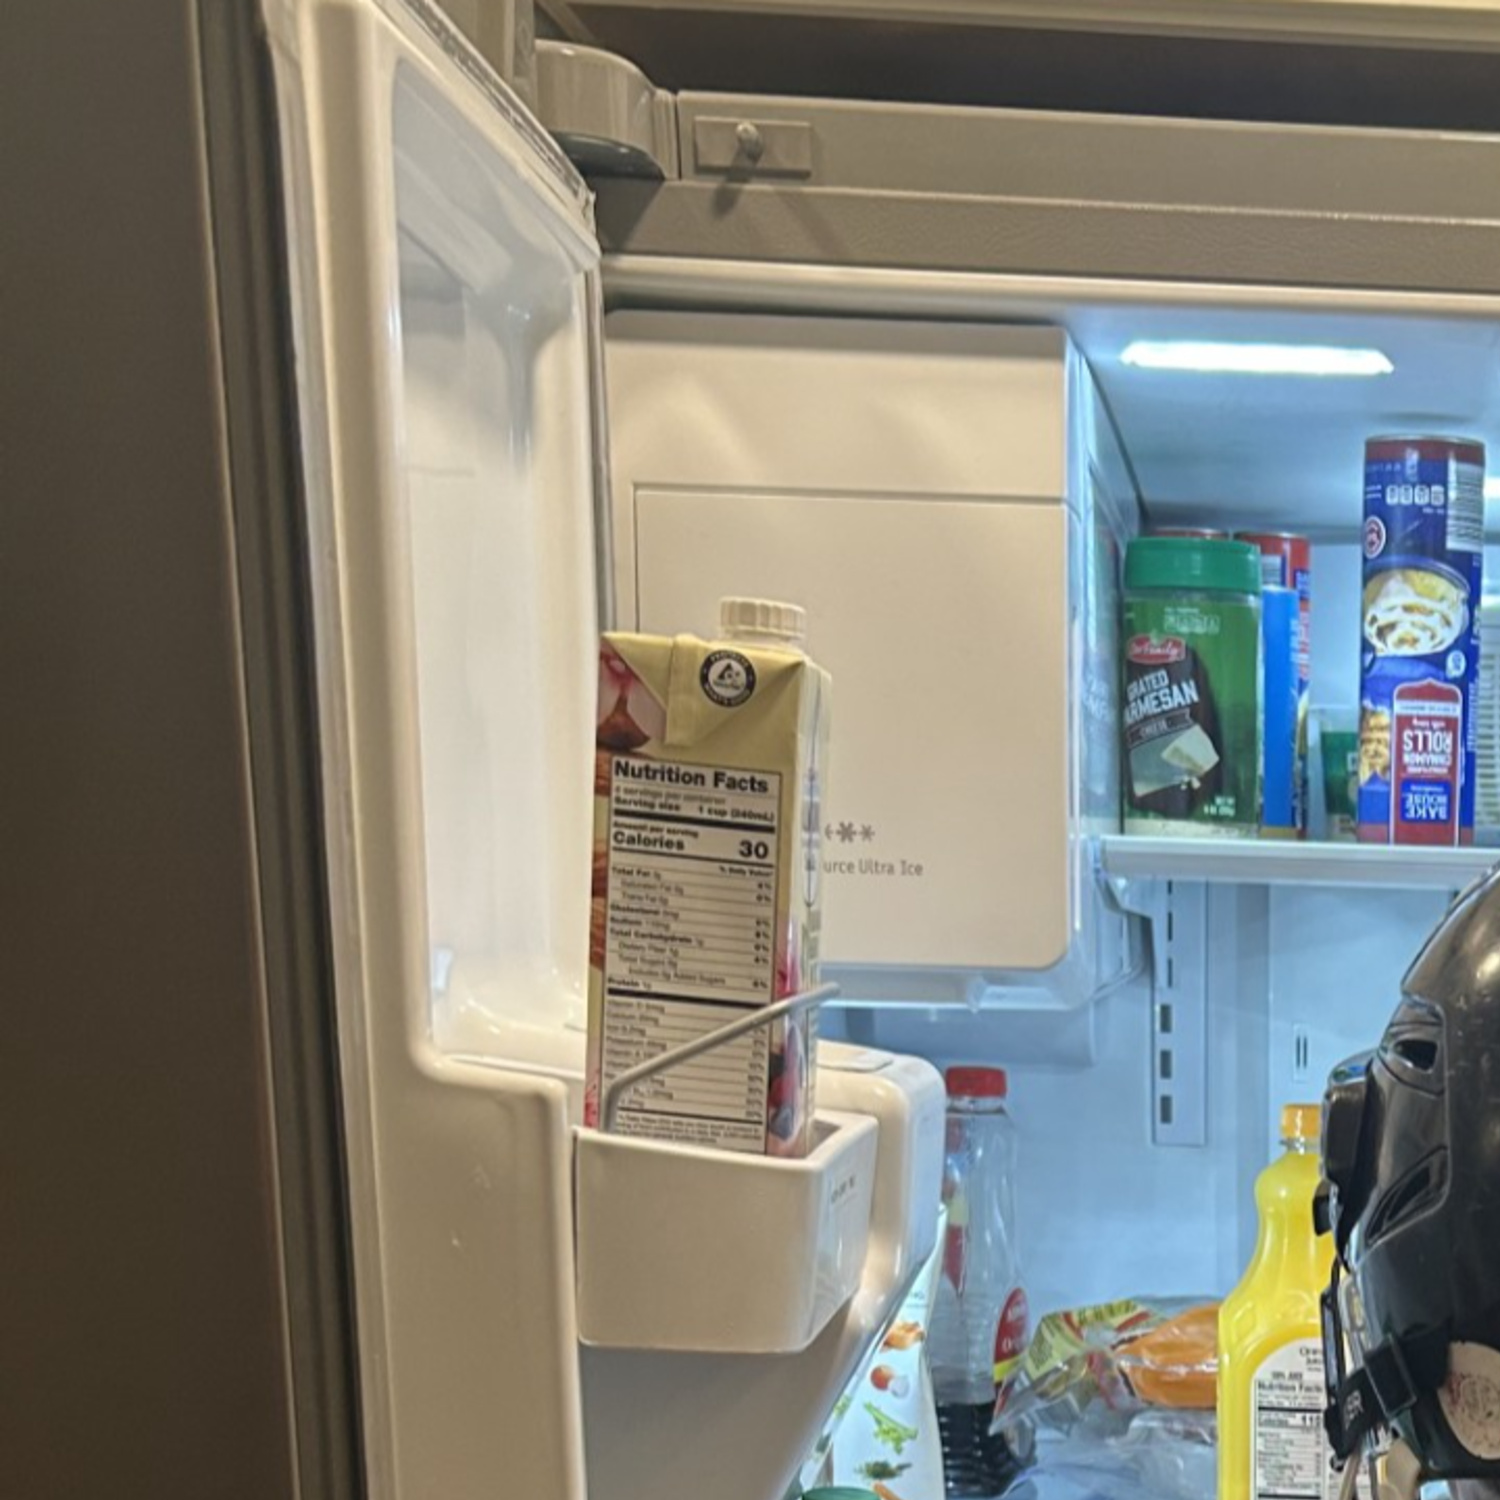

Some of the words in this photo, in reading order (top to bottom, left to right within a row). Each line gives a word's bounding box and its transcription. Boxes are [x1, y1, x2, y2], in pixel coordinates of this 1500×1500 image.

[1124, 679, 1199, 724] ARMESAN
[1403, 729, 1453, 754] ROLLS
[614, 760, 705, 787] Nutrition
[713, 771, 769, 793] Facts
[614, 796, 656, 811] Serving
[658, 801, 681, 811] size
[707, 806, 728, 818] cup
[612, 831, 686, 851] Calories
[738, 839, 770, 860] 30
[822, 861, 856, 875] urce
[857, 858, 896, 876] Ultra
[900, 859, 925, 877] Ice
